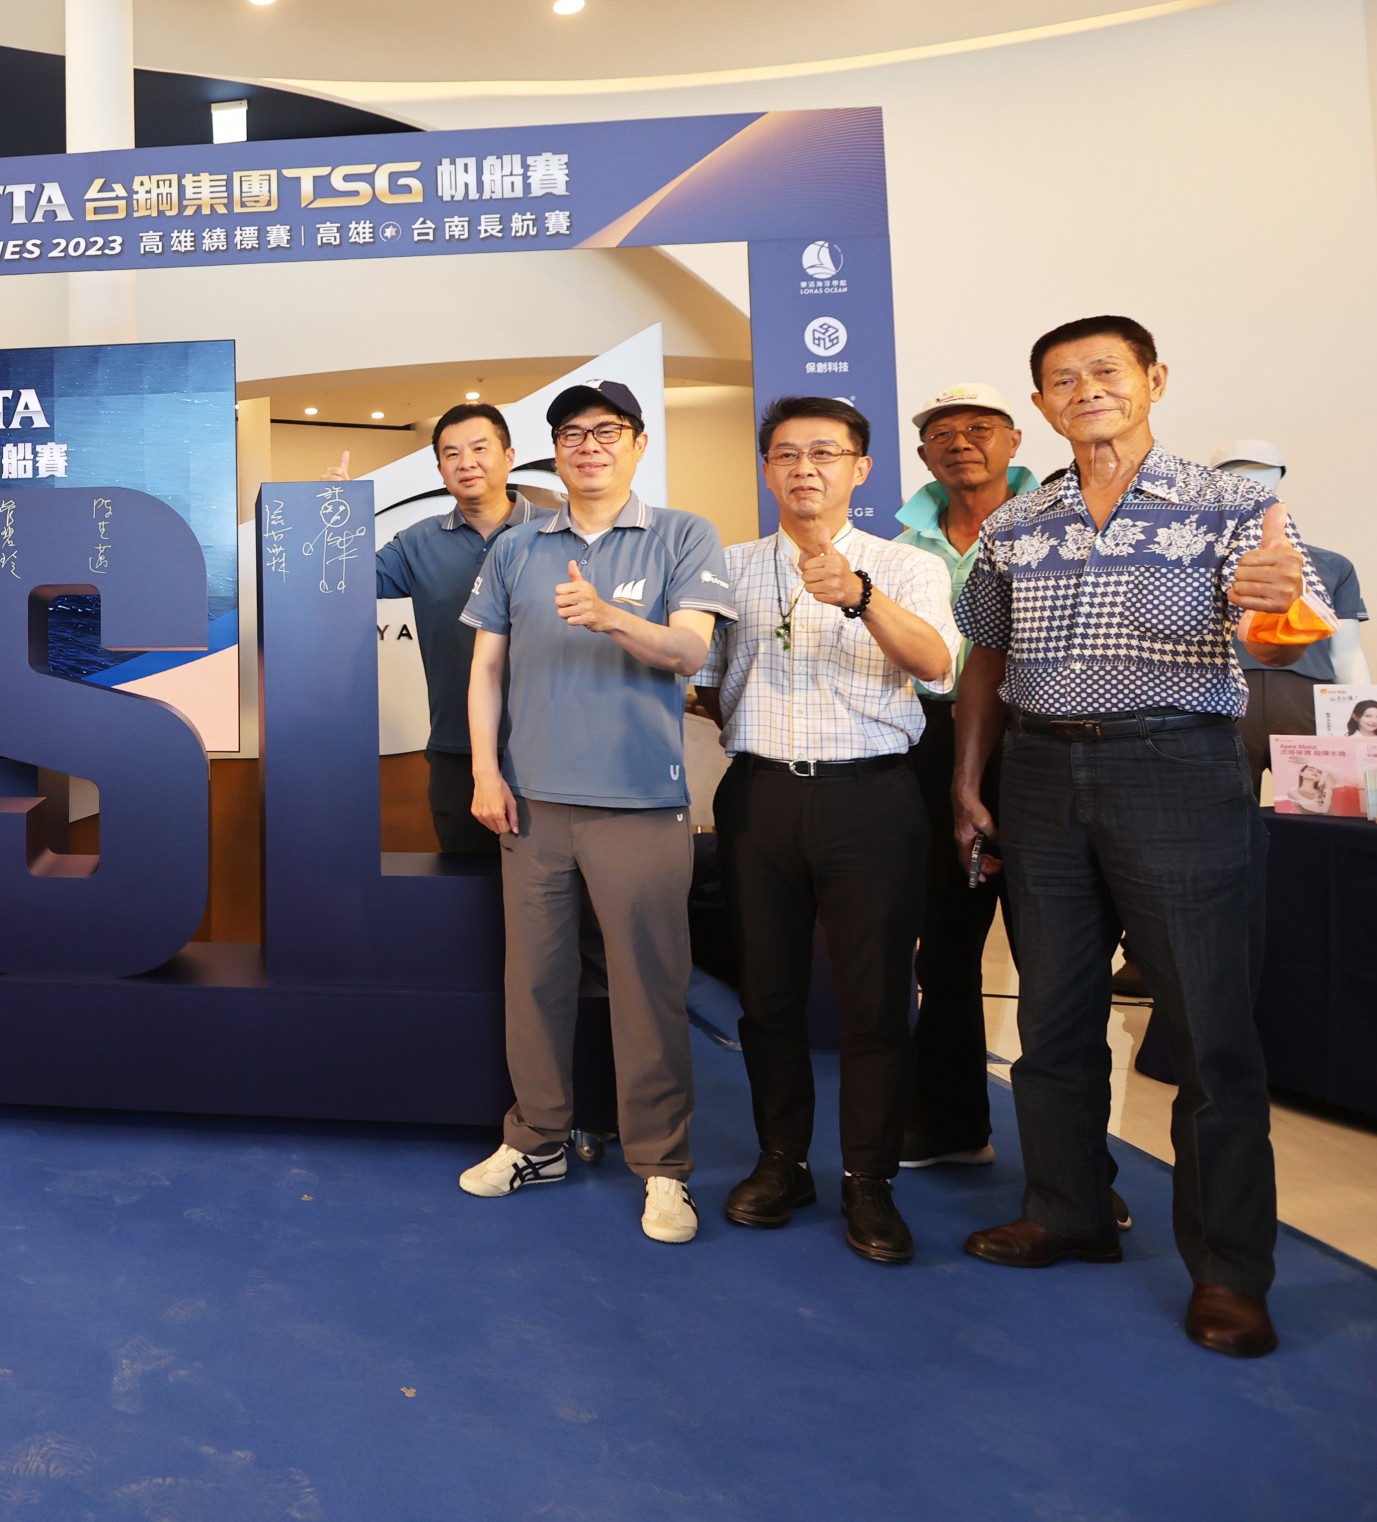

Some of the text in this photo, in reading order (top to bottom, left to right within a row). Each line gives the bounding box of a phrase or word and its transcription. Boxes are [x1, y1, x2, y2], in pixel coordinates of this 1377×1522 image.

[83, 168, 280, 222] 台鋼集團
[282, 161, 424, 209] TSG
[436, 151, 571, 203] 帆船賽
[47, 235, 123, 258] 2023
[138, 209, 571, 257] 高雄繞標賽 高雄 台南長航賽
[800, 286, 848, 295] LOHAS OCEAN
[805, 361, 850, 374] 保創科技
